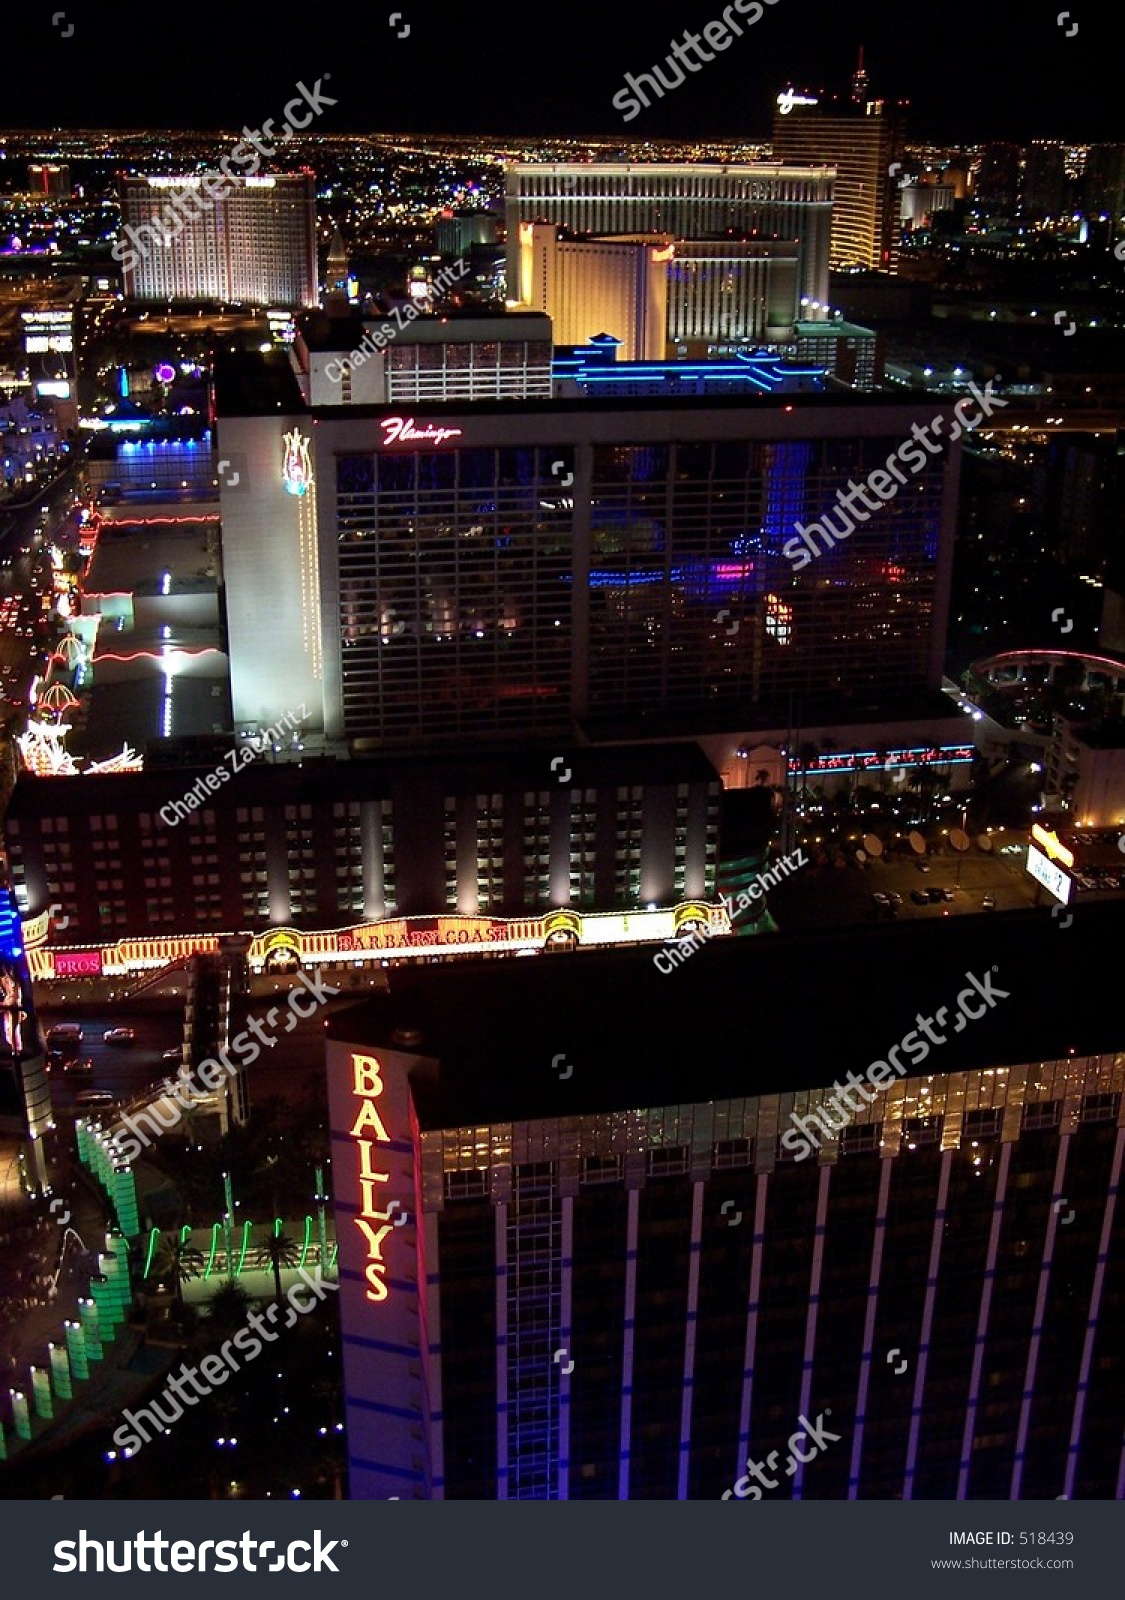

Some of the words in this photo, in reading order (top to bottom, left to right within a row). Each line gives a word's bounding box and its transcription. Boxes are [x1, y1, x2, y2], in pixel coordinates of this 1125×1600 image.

[381, 417, 462, 445] Flamingo
[338, 930, 439, 951] BARBARY
[445, 924, 508, 944] COAST
[56, 959, 100, 974] PROS
